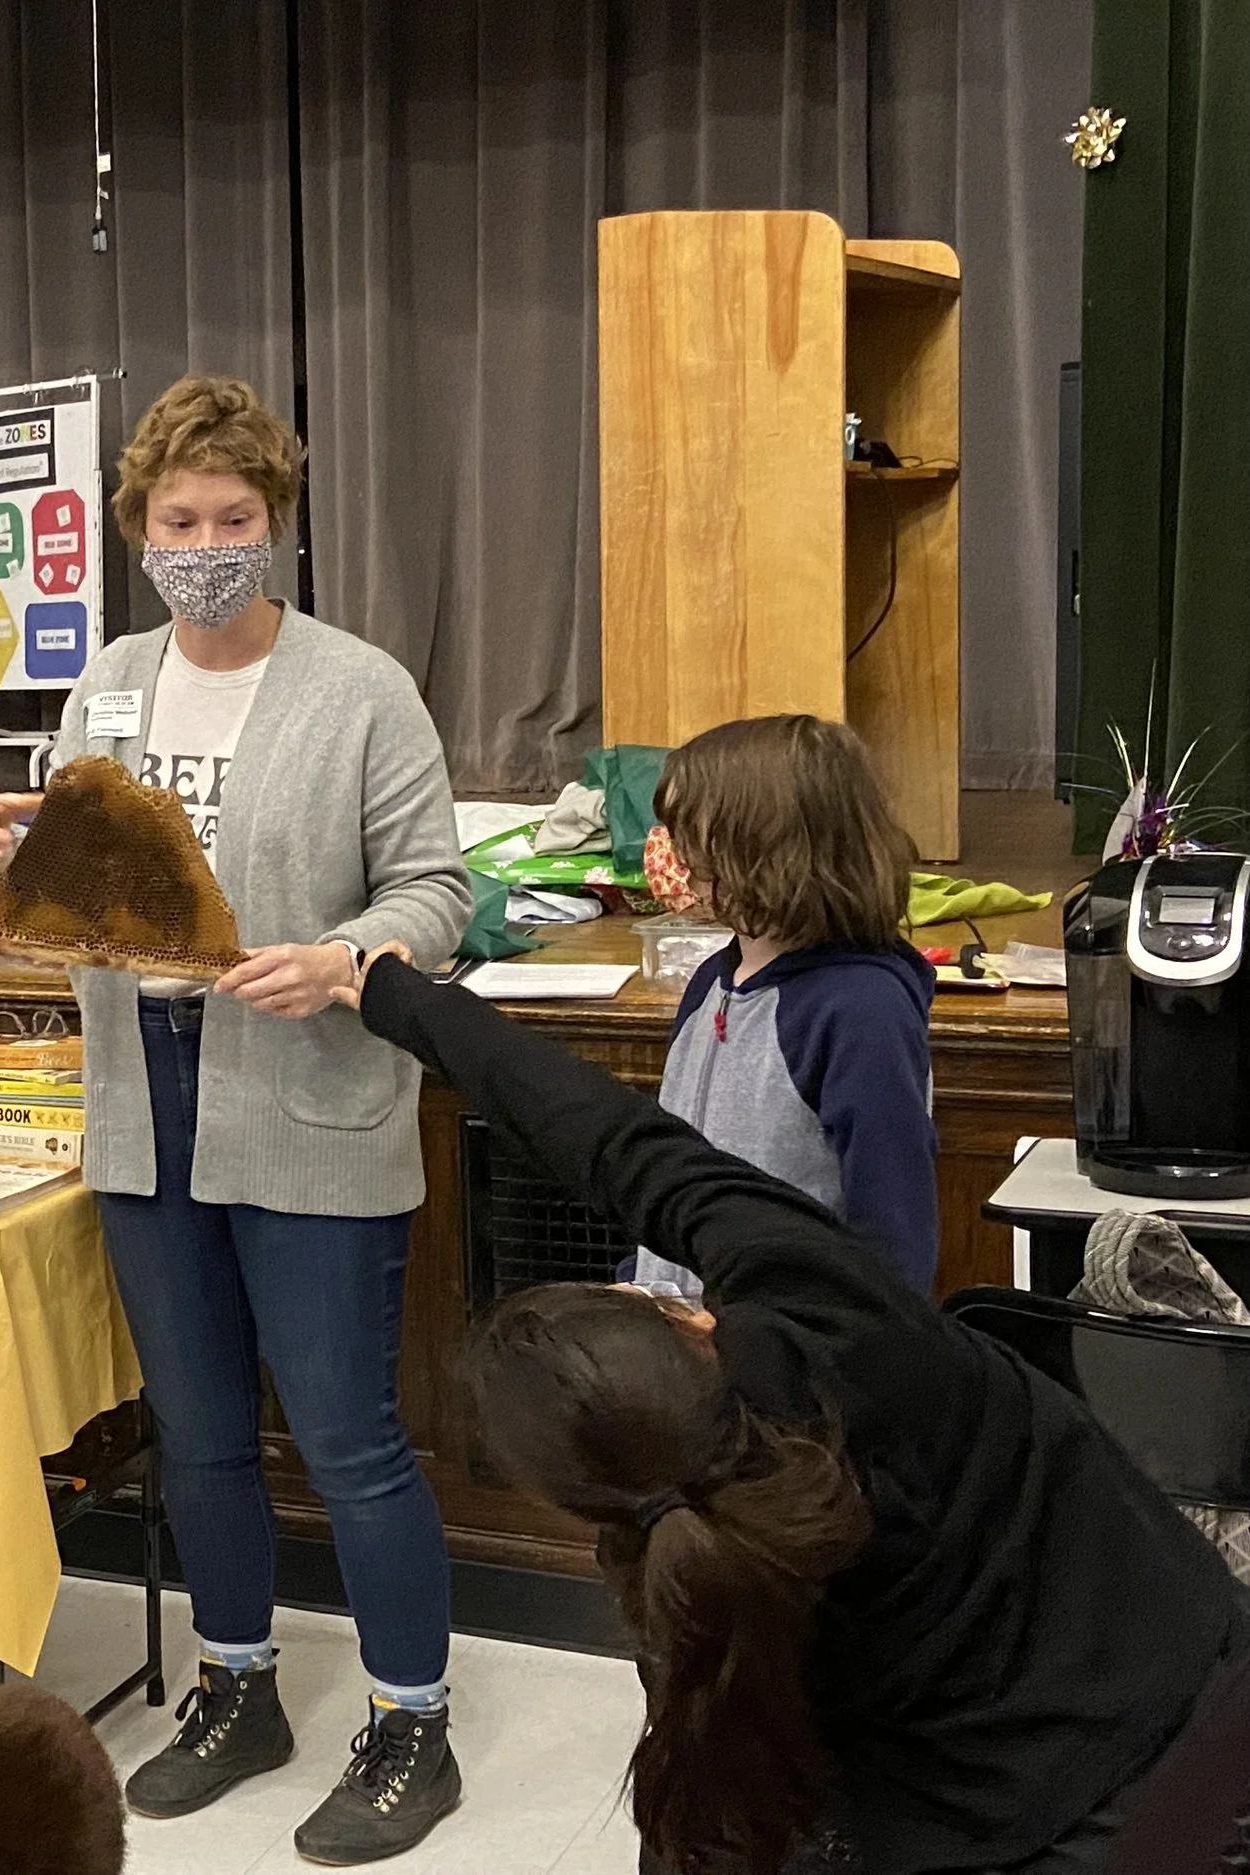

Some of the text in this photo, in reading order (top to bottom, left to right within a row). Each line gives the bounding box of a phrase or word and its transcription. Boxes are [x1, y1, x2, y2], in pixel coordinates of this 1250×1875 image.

[5, 423, 47, 444] ZONES
[99, 694, 133, 702] VISITOR
[13, 1134, 35, 1146] BIBLE
